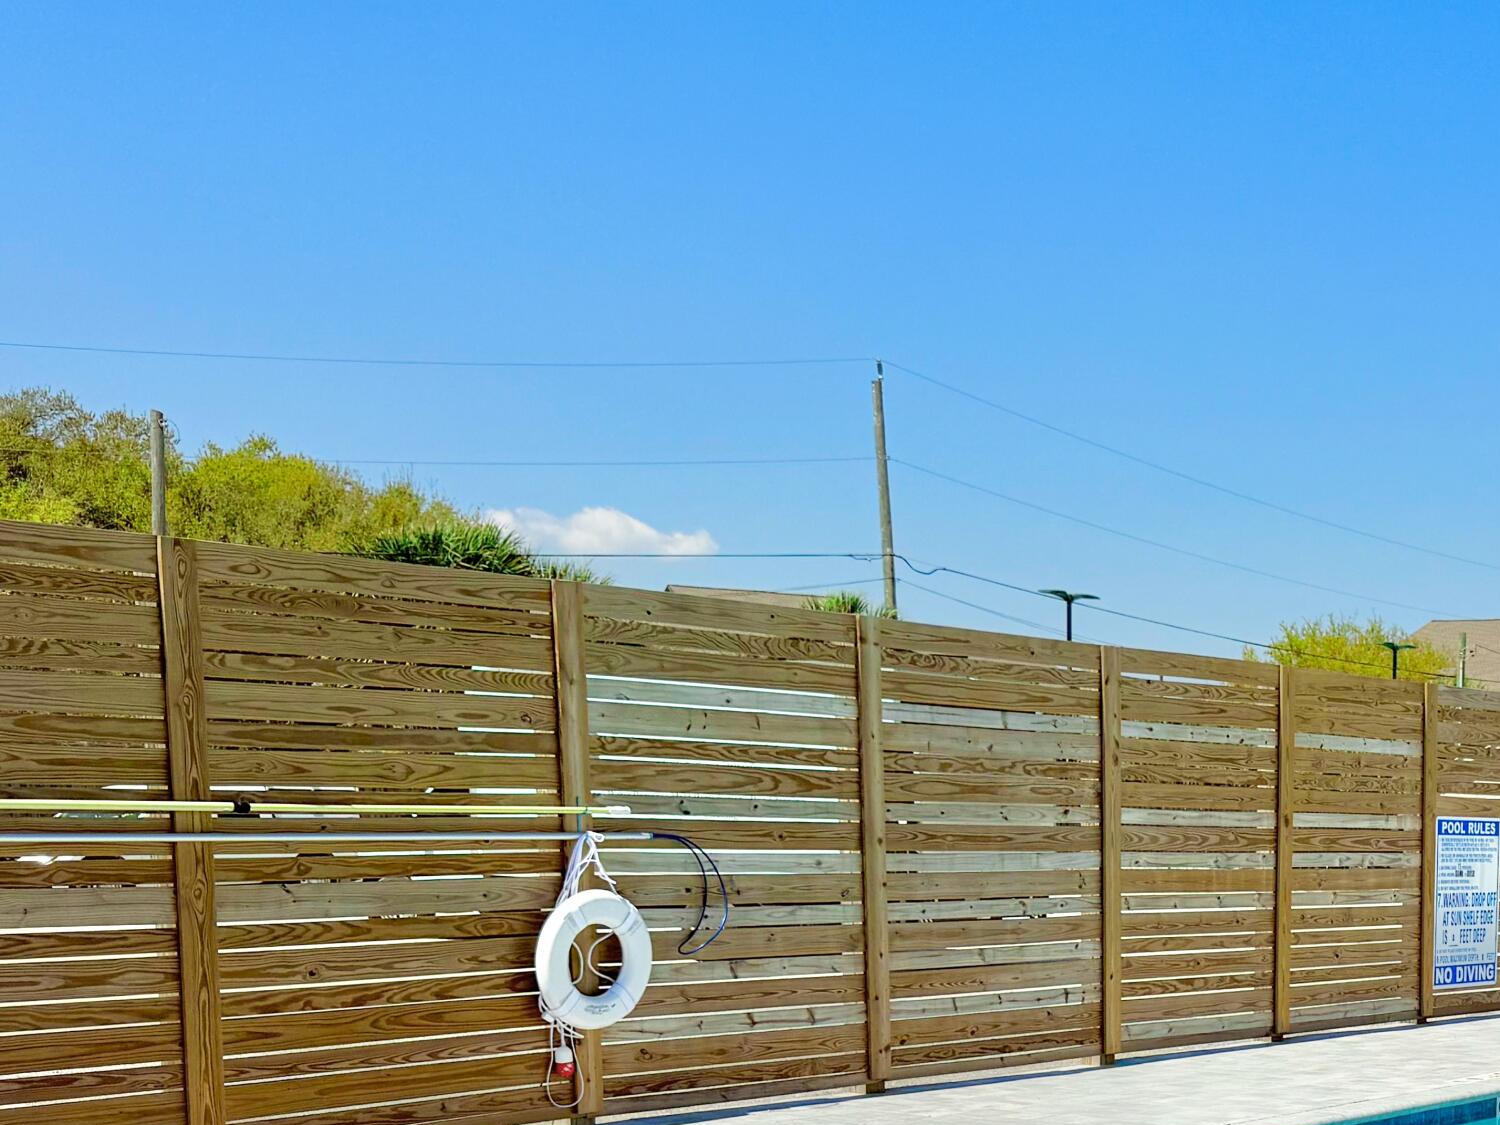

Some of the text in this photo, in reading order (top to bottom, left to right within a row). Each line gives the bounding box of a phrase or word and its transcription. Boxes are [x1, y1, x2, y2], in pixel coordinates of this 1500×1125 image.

[1441, 821, 1496, 834] POOL RULES
[1472, 892, 1486, 907] DROP
[1487, 892, 1497, 906] OFF
[1442, 910, 1494, 926] AT SUN SHELF EDGE
[1442, 929, 1448, 944] IS
[1460, 929, 1472, 944] FEET
[1473, 928, 1486, 942] DEEP
[1435, 964, 1494, 984] NO DIVING
